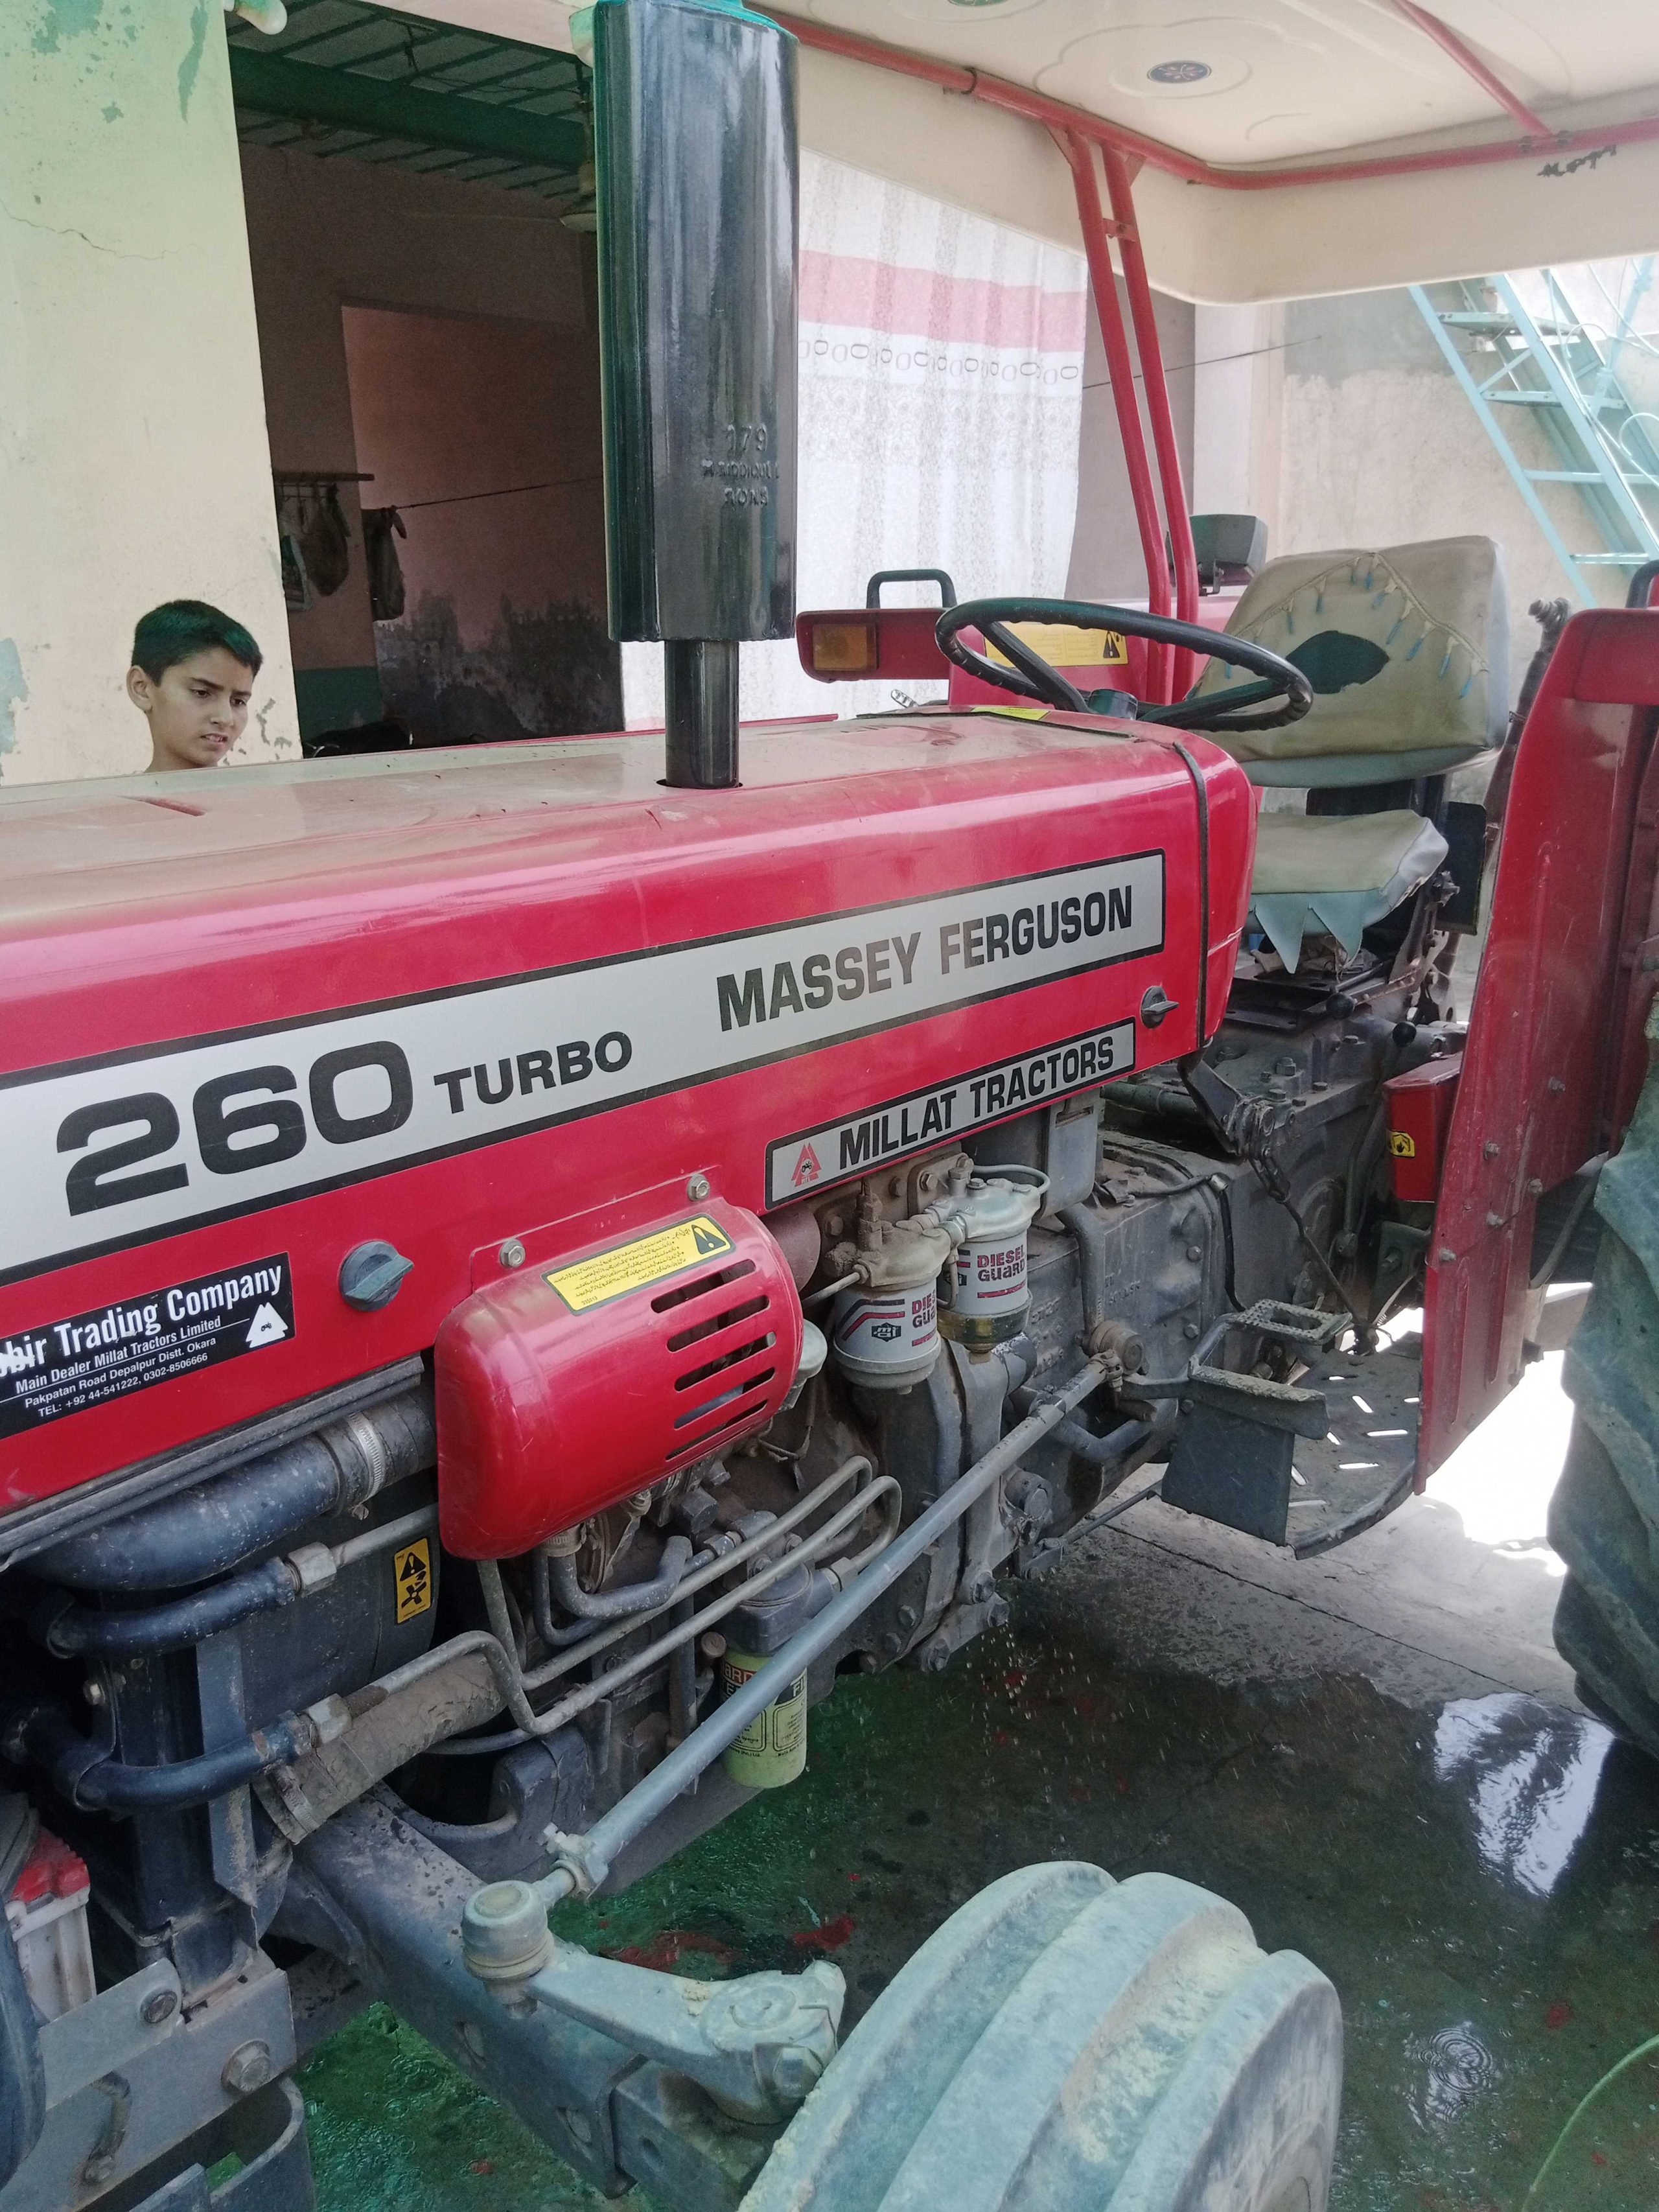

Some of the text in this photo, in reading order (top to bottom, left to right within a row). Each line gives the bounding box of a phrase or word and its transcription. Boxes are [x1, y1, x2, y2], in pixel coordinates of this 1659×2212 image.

[717, 885, 1132, 1032] MASSEY FERGUSON
[56, 1031, 632, 1217] 260 TURBO
[840, 1036, 1113, 1169] MILLAT TRACTORS
[977, 1244, 1025, 1268] DIESEL
[54, 1303, 161, 1356] Trading
[167, 1265, 282, 1321] Company
[16, 1315, 222, 1394] Main Dealer Millat Tractors Limited
[25, 1384, 76, 1408] Pakpatan
[78, 1372, 107, 1390] Road
[110, 1357, 156, 1380] Depalpur
[187, 1337, 216, 1353] Okara
[38, 1404, 62, 1417] TEL:
[65, 1394, 86, 1408] +92
